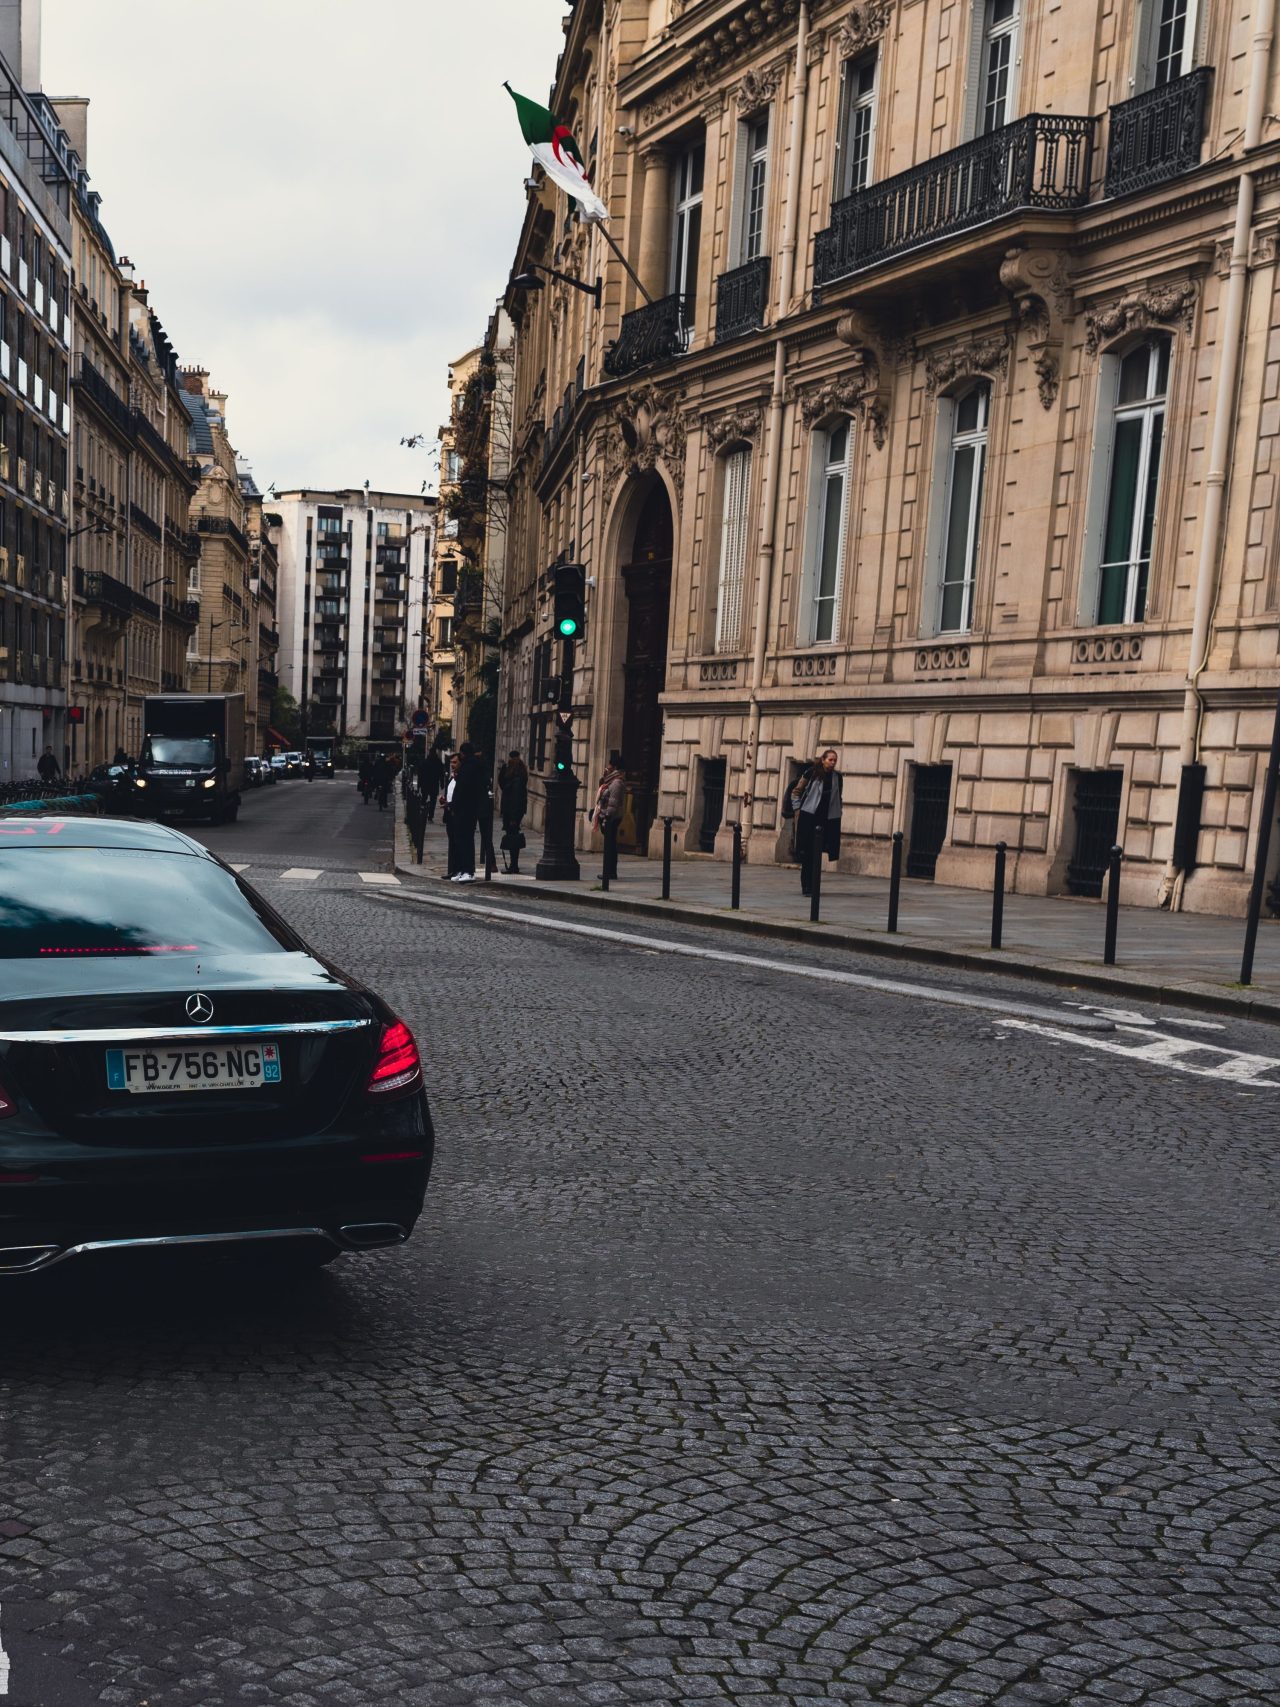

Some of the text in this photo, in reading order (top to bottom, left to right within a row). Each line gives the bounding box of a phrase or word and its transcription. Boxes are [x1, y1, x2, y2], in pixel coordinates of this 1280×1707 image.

[114, 1050, 279, 1082] F FB-756-NG 92
